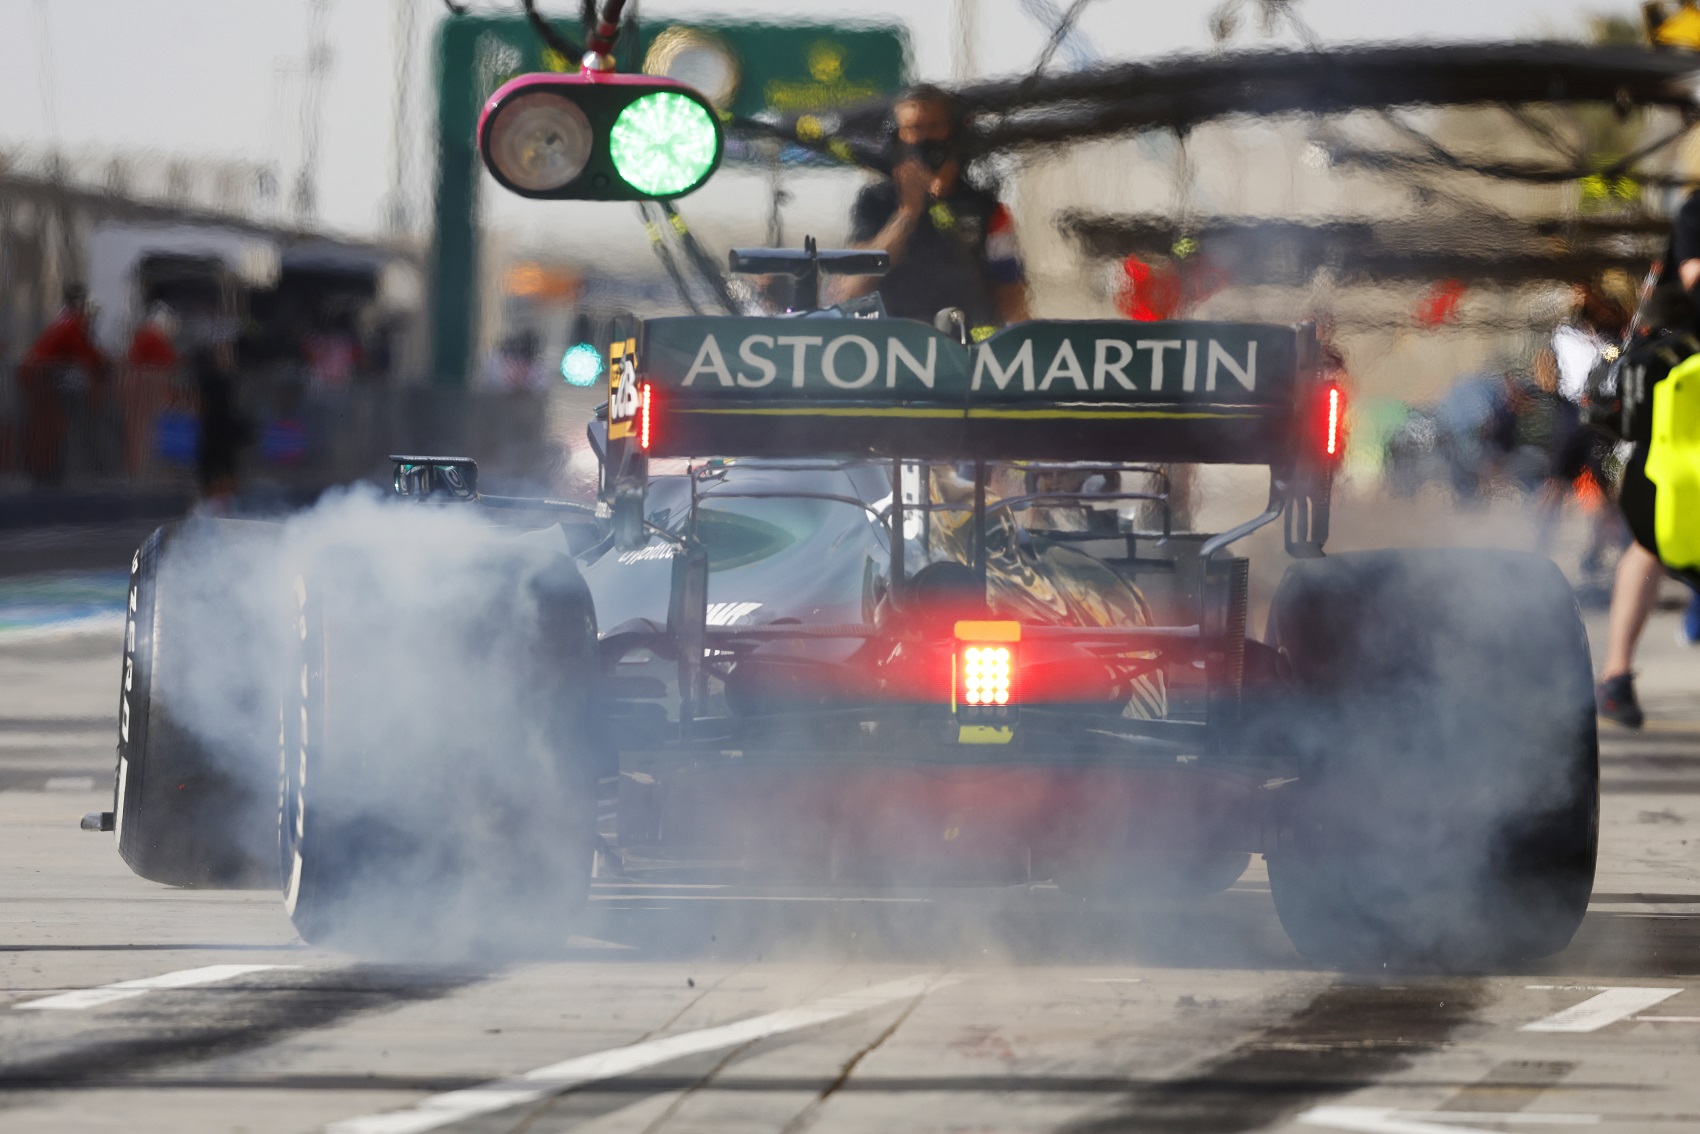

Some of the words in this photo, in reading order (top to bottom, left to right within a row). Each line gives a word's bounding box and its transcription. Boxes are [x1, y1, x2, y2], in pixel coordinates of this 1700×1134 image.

[681, 334, 937, 389] ASTON
[971, 338, 1258, 392] MARTIN
[120, 585, 137, 743] ZERO
